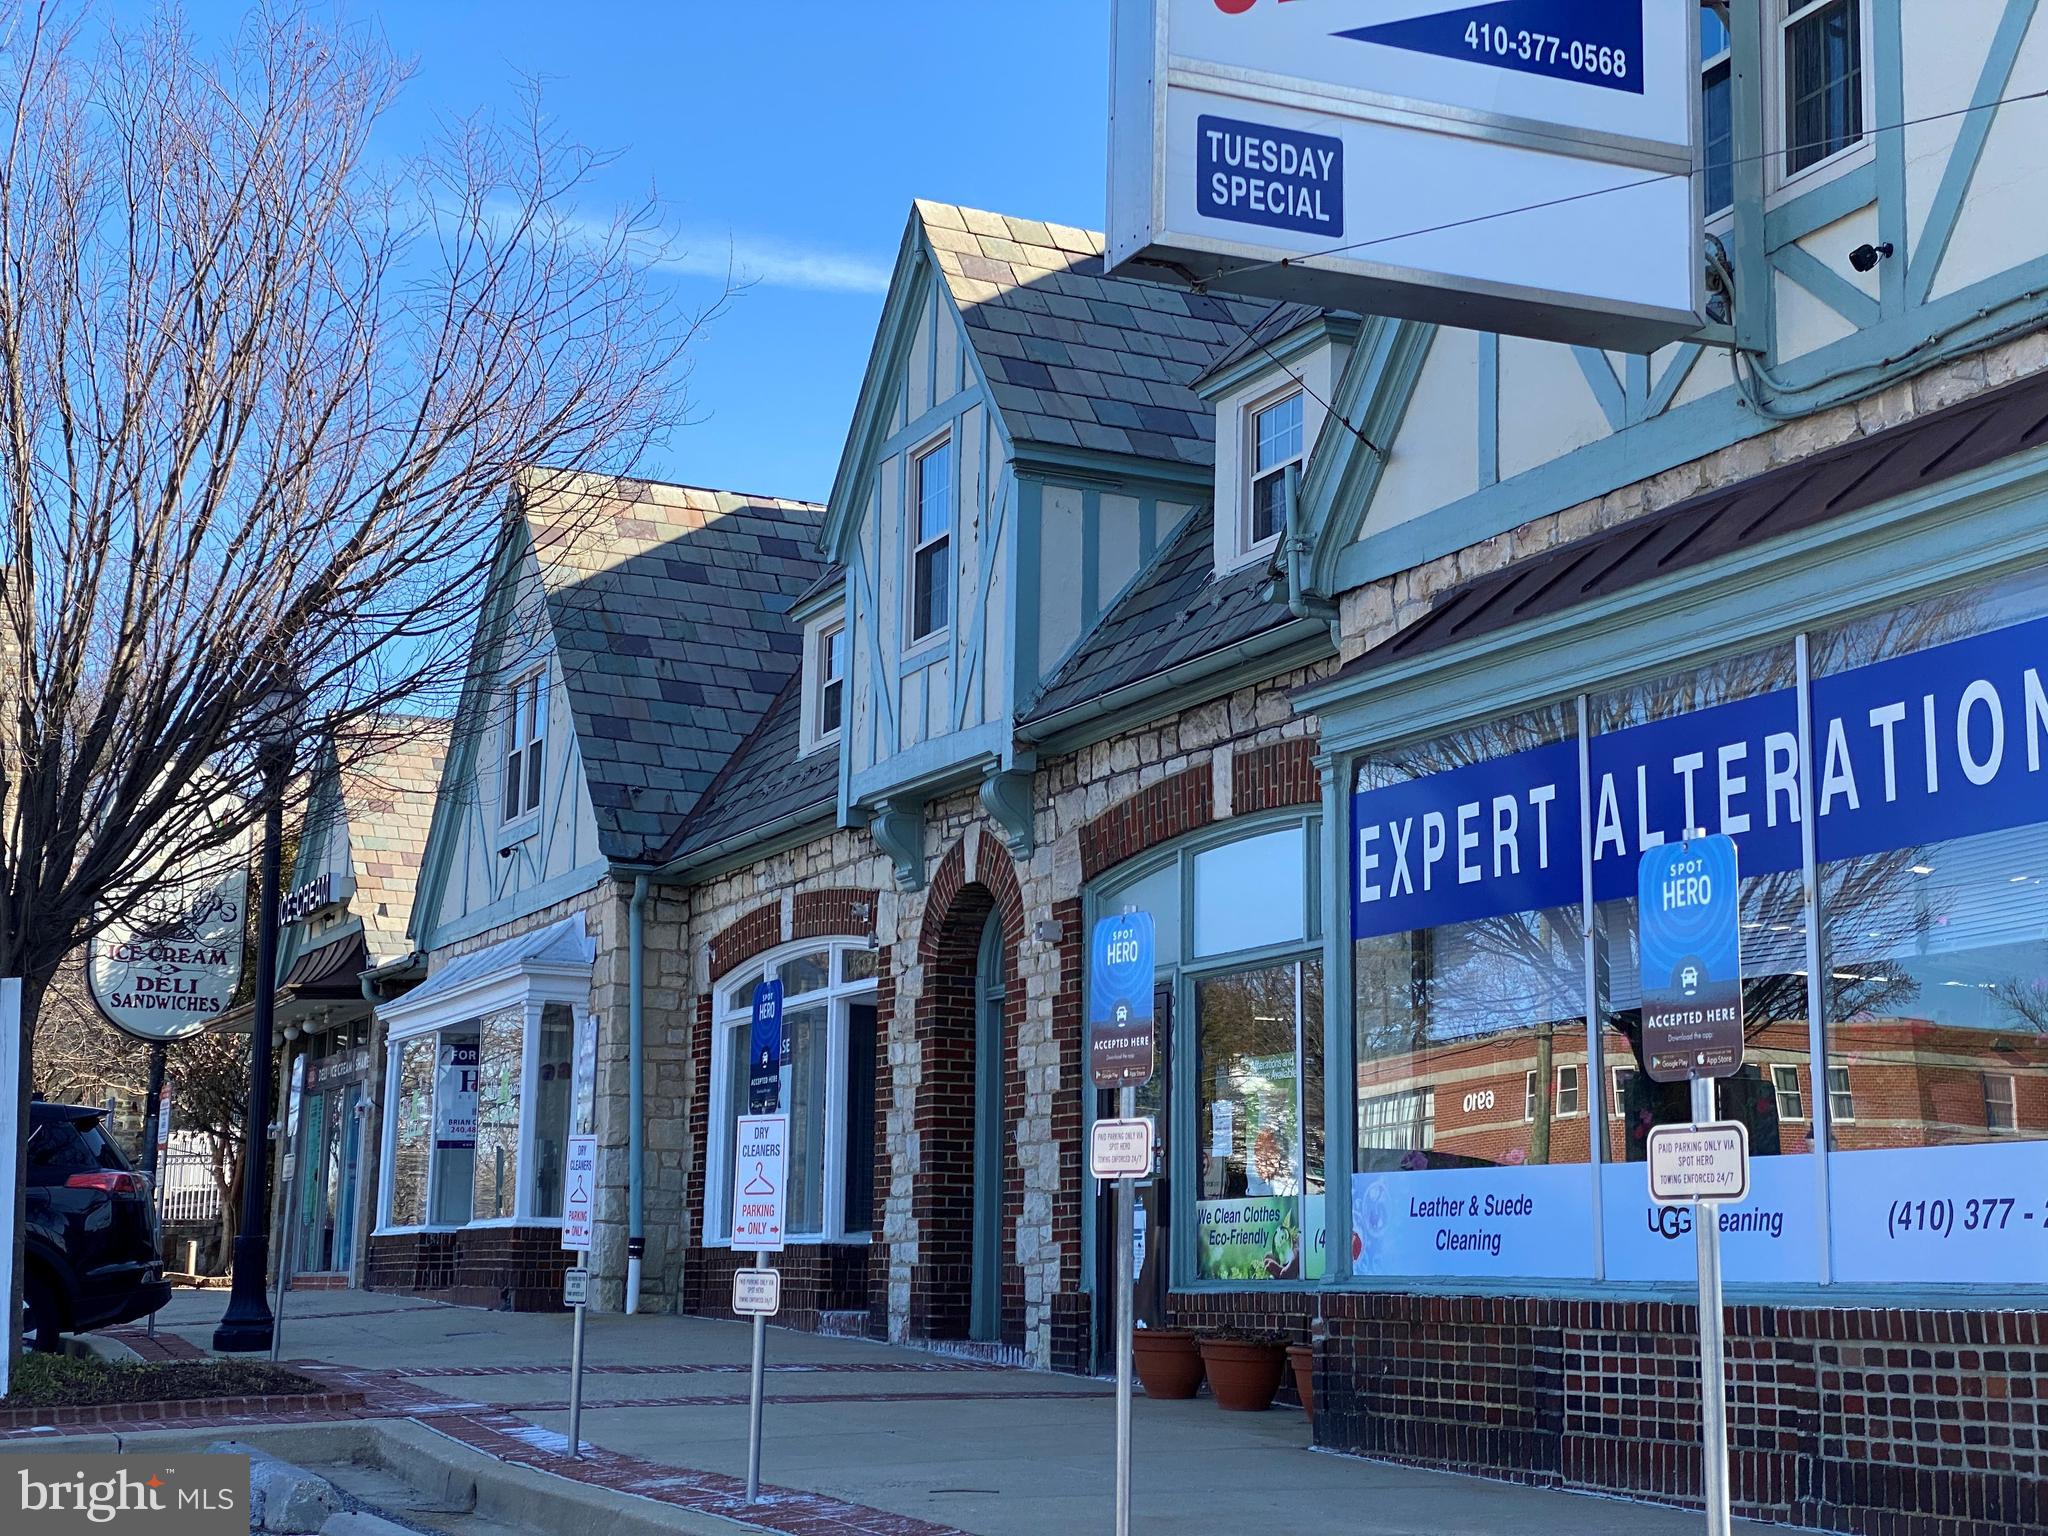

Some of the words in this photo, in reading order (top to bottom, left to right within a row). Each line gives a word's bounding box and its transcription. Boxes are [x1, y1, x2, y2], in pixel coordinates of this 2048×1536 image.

[1464, 21, 1627, 78] 410-377-0568
[1206, 130, 1334, 181] TUESDAY
[1212, 172, 1330, 222] SPECIAL
[1360, 784, 1556, 903] EXPERT
[1670, 859, 1703, 877] SPOT
[1663, 875, 1711, 911] HERO
[1113, 929, 1133, 941] SPOT
[1107, 941, 1138, 966] HERO
[136, 976, 198, 994] DELI
[110, 993, 220, 1013] SANDWICHES
[759, 1002, 775, 1020] HERO
[1648, 1011, 1702, 1028] ACCEPTED
[1707, 1007, 1735, 1022] HERE
[1094, 1038, 1129, 1050] ACCEPTED
[1131, 1036, 1149, 1047] HERE
[452, 1050, 476, 1061] FOR
[1706, 1056, 1717, 1065] App
[1718, 1055, 1732, 1063] Store
[1662, 1060, 1678, 1069] Google
[448, 1118, 471, 1126] BRIAN
[754, 1127, 770, 1140] DRY
[577, 1145, 587, 1156] DRY
[742, 1144, 780, 1158] CLEANERS
[1658, 1143, 1673, 1154] PAID
[1675, 1142, 1702, 1152] PARKING
[1704, 1140, 1721, 1151] ONLY
[1723, 1140, 1734, 1150] VIA
[570, 1160, 592, 1171] CLEANERS
[1678, 1156, 1694, 1167] SPOT
[1696, 1155, 1713, 1165] HERO
[1660, 1174, 1682, 1185] TOWING
[1684, 1173, 1715, 1184] ENFORCED
[1717, 1172, 1734, 1186] 24/7
[742, 1204, 775, 1217] PARKING
[1410, 1196, 1464, 1218] Leather
[1468, 1195, 1479, 1217] &
[1484, 1193, 1533, 1216] Suede
[568, 1211, 588, 1222] PARKING
[1198, 1209, 1211, 1225] We
[1215, 1208, 1241, 1224] Clean
[1244, 1206, 1280, 1223] Clothes
[1648, 1206, 1692, 1239] UGG
[1888, 1199, 1954, 1239] (410)
[1964, 1198, 2015, 1230] 377
[571, 1226, 583, 1237] ONLY
[748, 1222, 767, 1235] ONLY
[1209, 1228, 1269, 1249] Eco-Friendly
[1436, 1229, 1501, 1256] Cleaning
